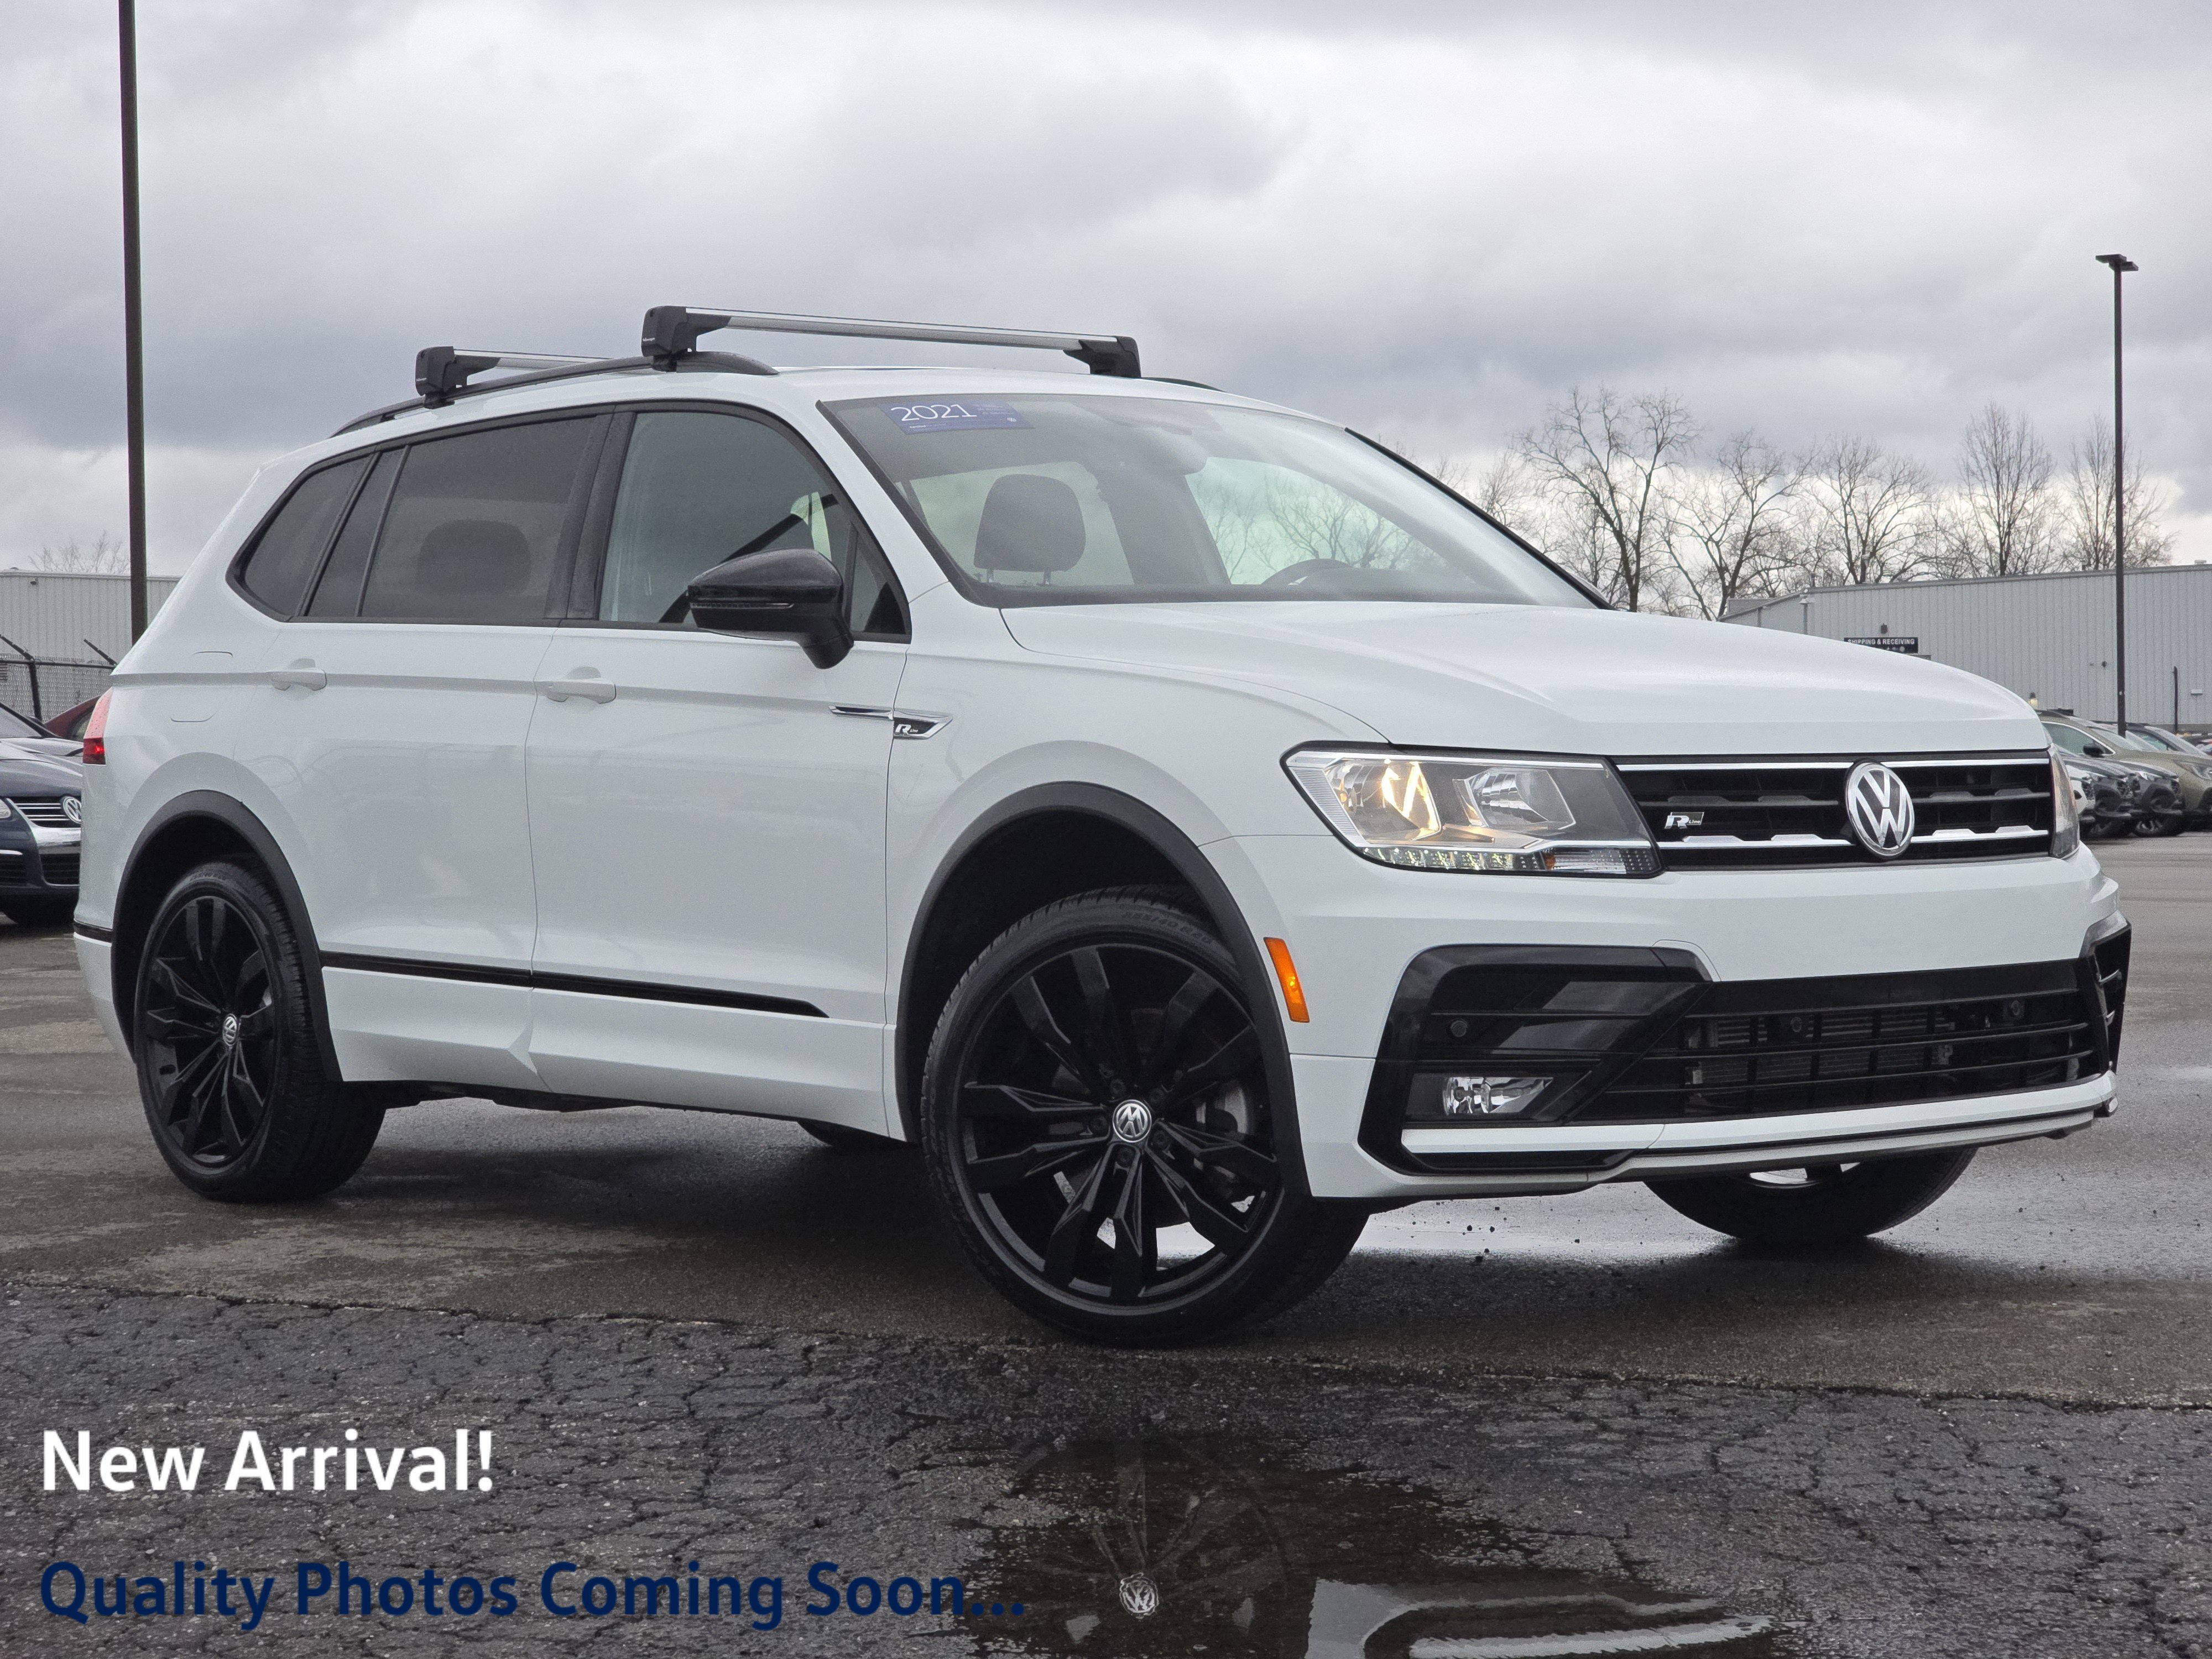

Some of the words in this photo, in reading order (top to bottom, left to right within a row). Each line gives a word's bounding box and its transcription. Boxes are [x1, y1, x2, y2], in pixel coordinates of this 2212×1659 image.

[891, 404, 977, 421] 2021
[895, 724, 911, 735] R
[1848, 764, 1913, 852] VW
[1665, 815, 1690, 829] R
[1115, 1102, 1149, 1139] VW
